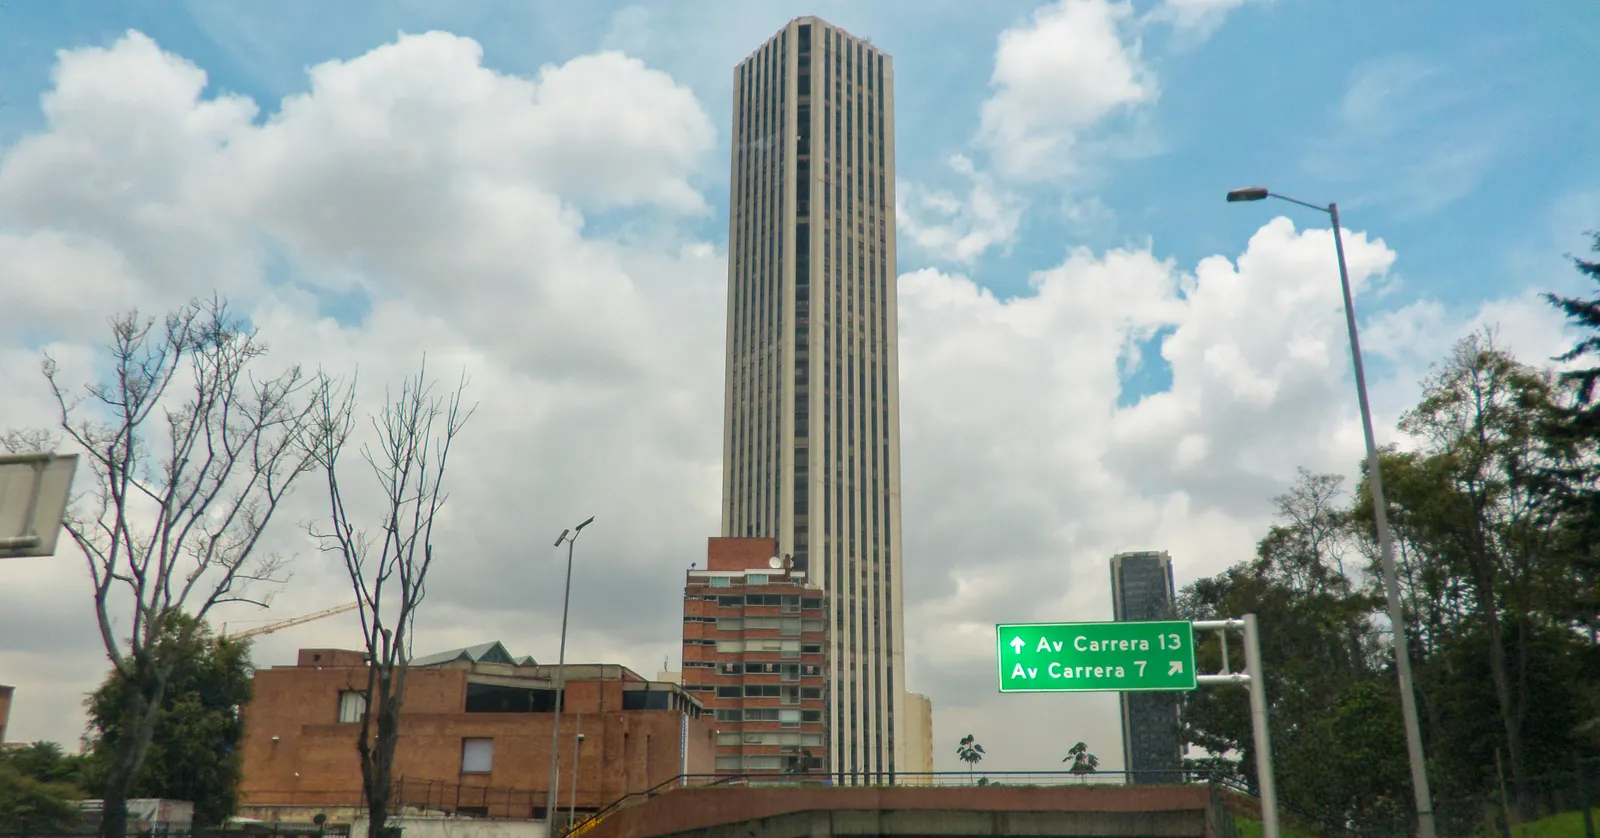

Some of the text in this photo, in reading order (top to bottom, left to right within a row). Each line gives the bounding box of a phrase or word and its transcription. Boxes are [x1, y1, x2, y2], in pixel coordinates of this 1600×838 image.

[1036, 633, 1182, 653] Av Carrera 13
[1011, 661, 1147, 680] Av Carrera 7
